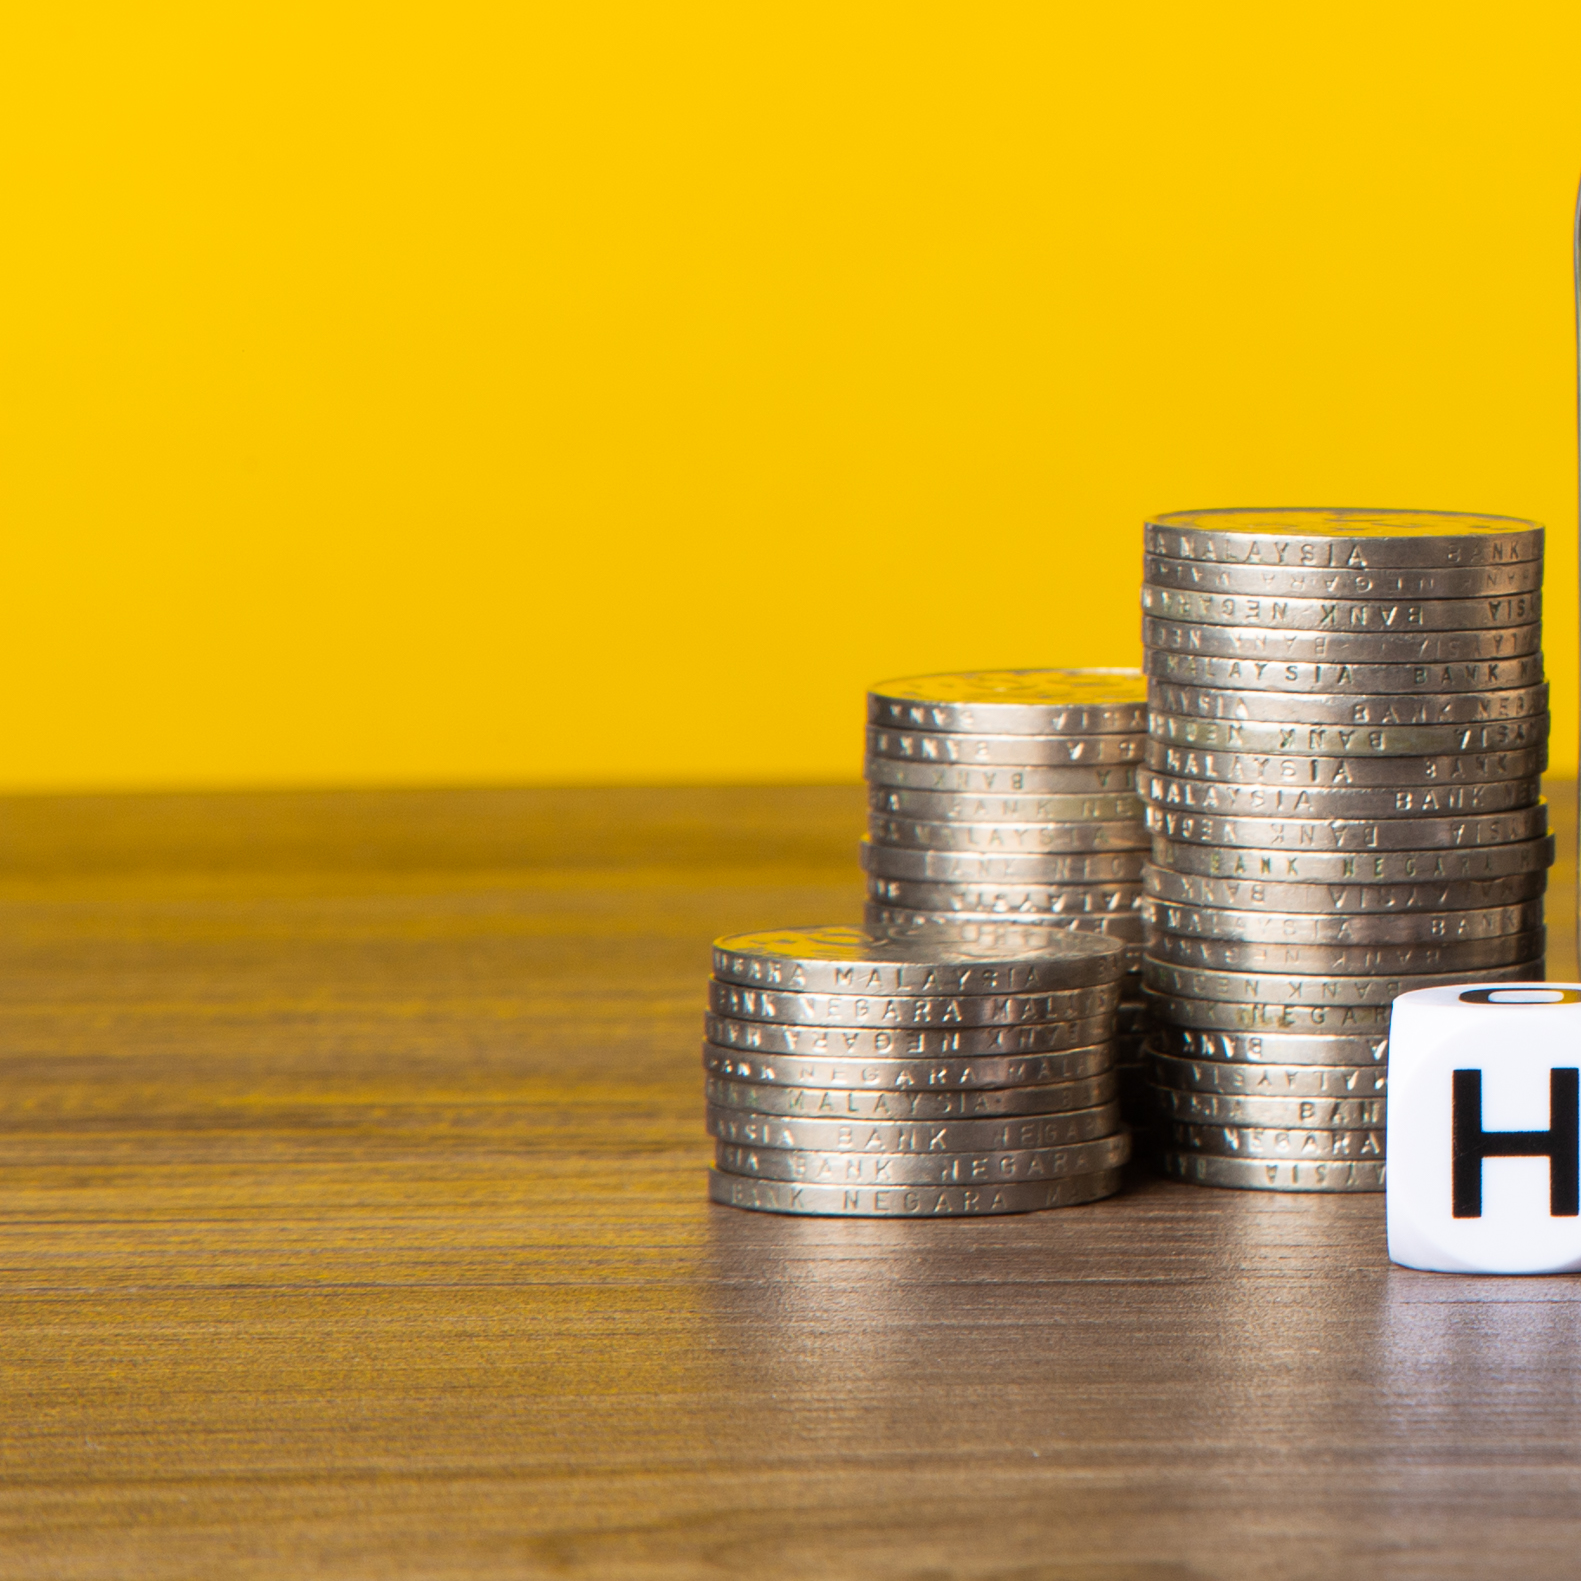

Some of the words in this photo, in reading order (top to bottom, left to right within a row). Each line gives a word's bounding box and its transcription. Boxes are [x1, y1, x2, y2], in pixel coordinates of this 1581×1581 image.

[1179, 536, 1370, 567] MALAYSIA
[1446, 539, 1520, 561] BANK
[1320, 602, 1425, 627] BANK
[1415, 660, 1499, 685] BANK
[1353, 695, 1451, 723] BANK
[1279, 725, 1387, 753] BANK
[934, 769, 1025, 792] BANK
[1166, 749, 1354, 784] MALAYSIA
[1394, 786, 1486, 811] BANK
[1270, 820, 1379, 848] BANK
[1210, 849, 1299, 877] BANK
[1342, 851, 1491, 878] NEGARA
[1180, 875, 1267, 905] BANK
[834, 963, 1042, 992] MALAYSIA
[1287, 978, 1402, 999] BANK
[799, 995, 963, 1023] NEGARA
[783, 1026, 961, 1055] NEGARA
[799, 1066, 977, 1087] NEGARA
[787, 1089, 989, 1116] MALAYSIA
[837, 1127, 949, 1151] BANK
[1222, 1127, 1382, 1155] NEGARA
[789, 1155, 893, 1183] BANK
[842, 1189, 1009, 1215] NEGARA
